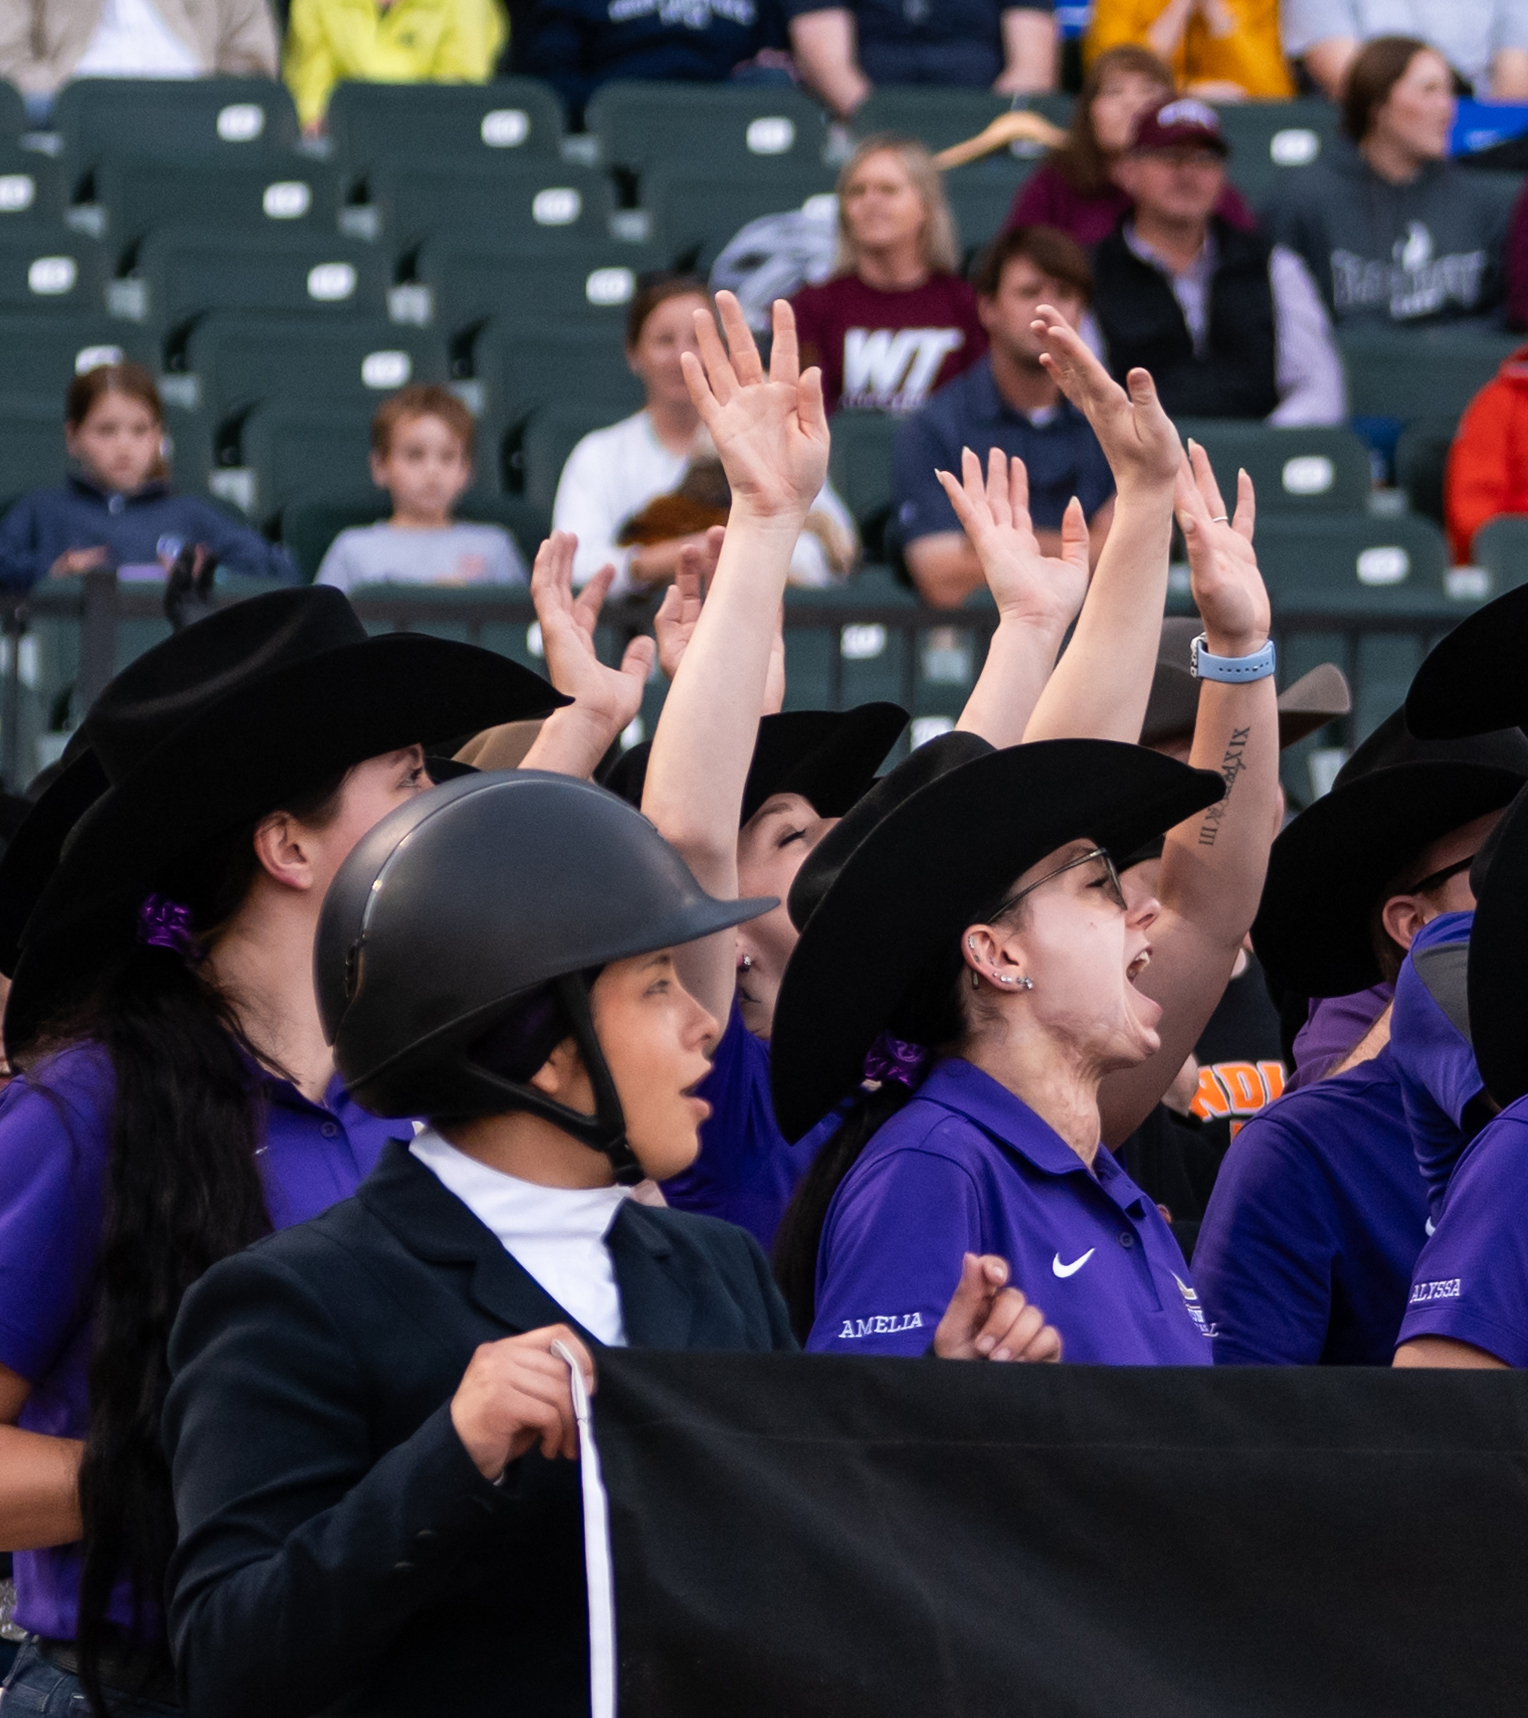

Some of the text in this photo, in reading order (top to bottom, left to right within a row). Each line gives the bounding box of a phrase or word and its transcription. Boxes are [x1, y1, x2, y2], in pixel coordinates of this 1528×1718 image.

[842, 327, 966, 406] WT
[1409, 1278, 1461, 1304] ALYSSA
[838, 1311, 923, 1338] AMELIA
